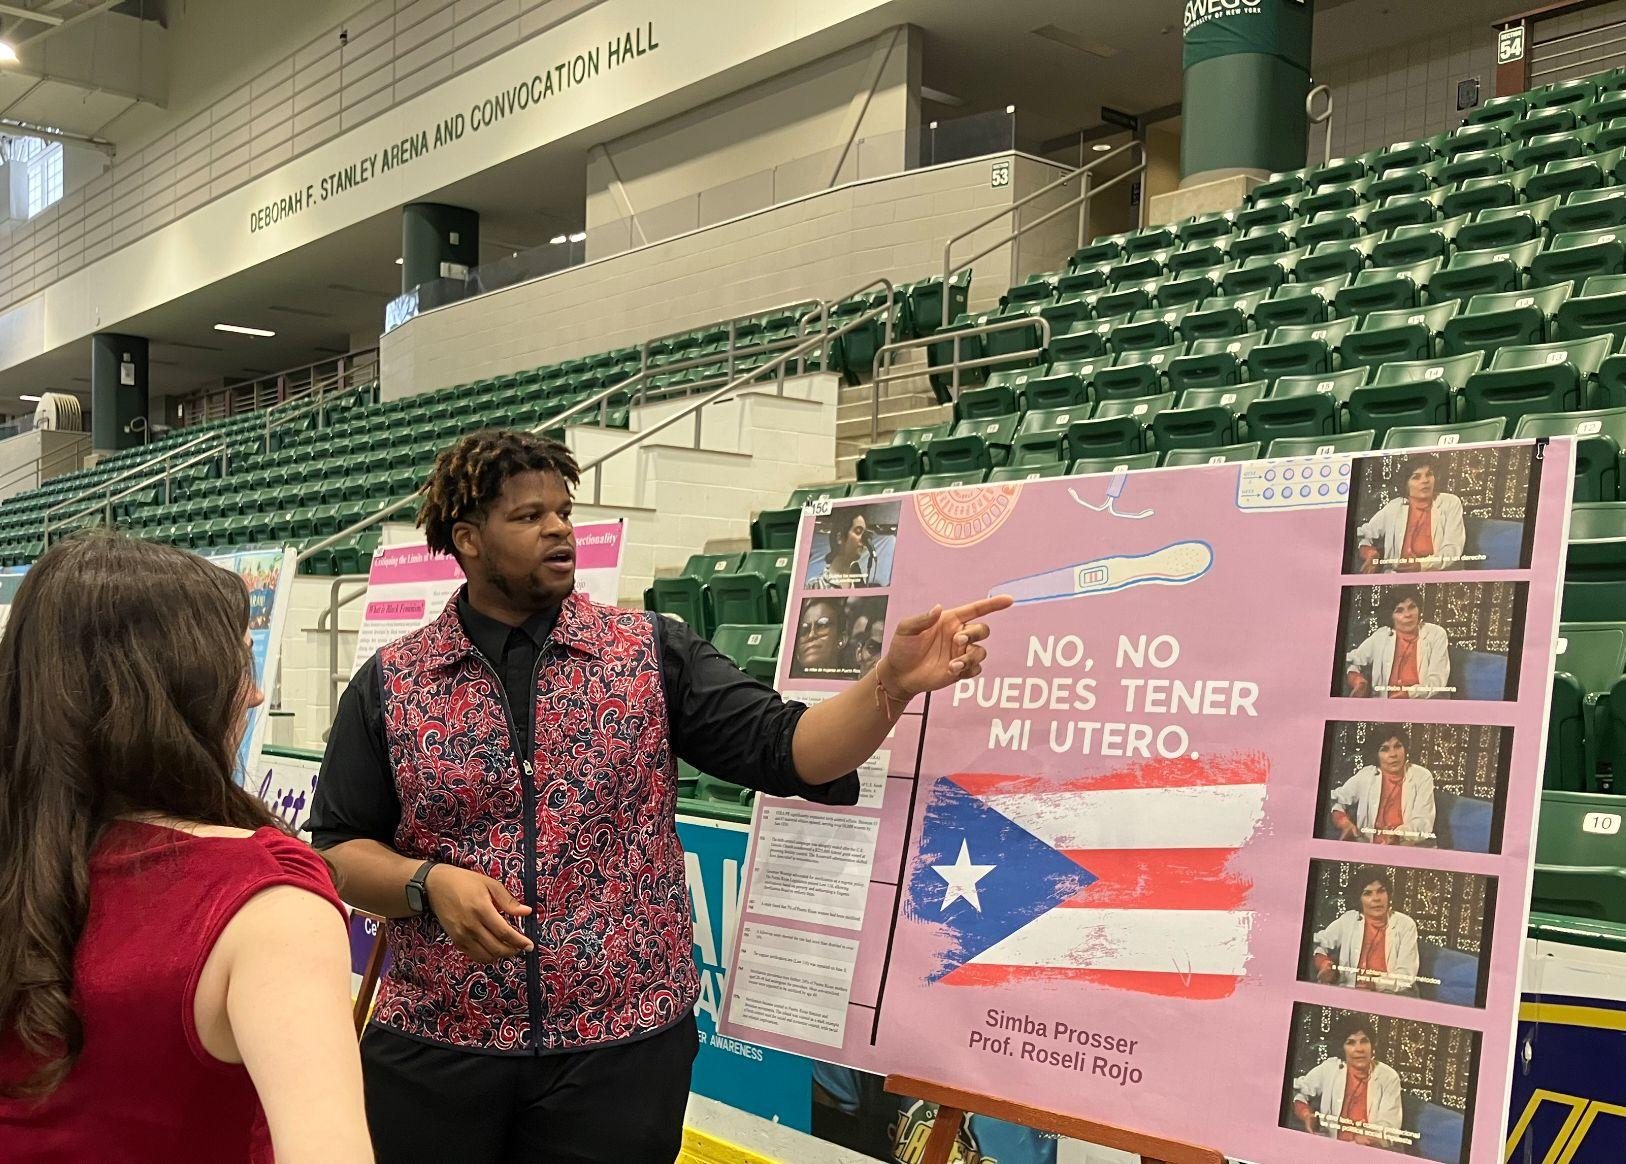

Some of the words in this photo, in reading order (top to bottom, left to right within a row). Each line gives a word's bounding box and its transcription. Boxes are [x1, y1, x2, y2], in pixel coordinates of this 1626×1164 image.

[1500, 37, 1521, 59] 54
[250, 190, 302, 233] DEBORAH
[306, 185, 316, 207] F.
[320, 154, 377, 201] STANLEY
[381, 131, 428, 173] ARENA
[434, 113, 465, 149] AND
[470, 46, 600, 131] CONVOCATION
[608, 21, 659, 69] HALL
[992, 168, 1008, 186] 53
[1026, 634, 1095, 672] NO,
[1115, 634, 1181, 669] NO
[952, 676, 1097, 711] PUEDES
[1121, 679, 1259, 717] TENER
[988, 718, 1032, 751] MI
[1050, 721, 1200, 760] UTERO.
[1594, 817, 1612, 830] 10
[709, 1035, 763, 1062] AWARENESS
[985, 1008, 1048, 1038] Simba
[1053, 1021, 1138, 1055] Prosser
[968, 1030, 1013, 1057] Prof.
[1020, 1041, 1086, 1072] Roseli
[1091, 1055, 1143, 1086] Rojo
